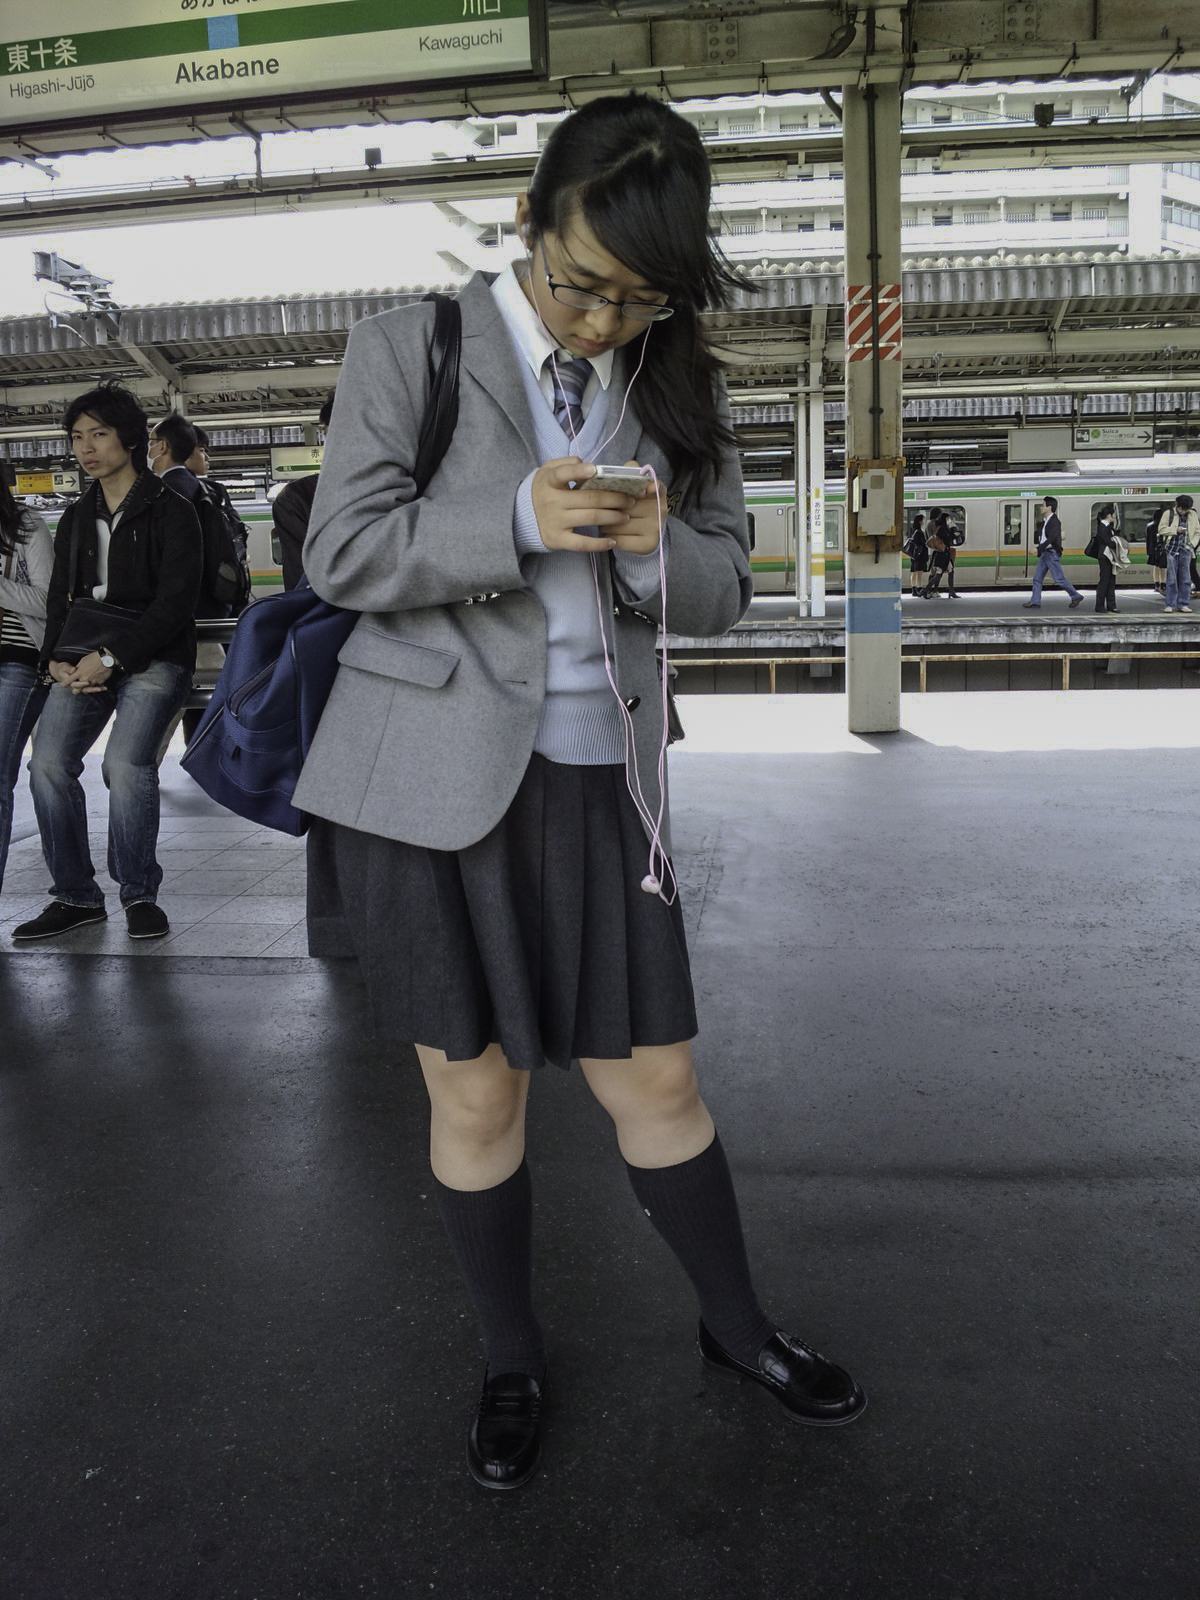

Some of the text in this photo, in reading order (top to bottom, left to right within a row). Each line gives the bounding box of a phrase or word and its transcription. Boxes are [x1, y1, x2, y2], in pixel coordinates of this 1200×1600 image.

[419, 28, 503, 52] Kawaguchi
[6, 38, 78, 72] 東十条
[175, 58, 280, 84] Akabane
[9, 75, 96, 99] Higashi-Jūjō
